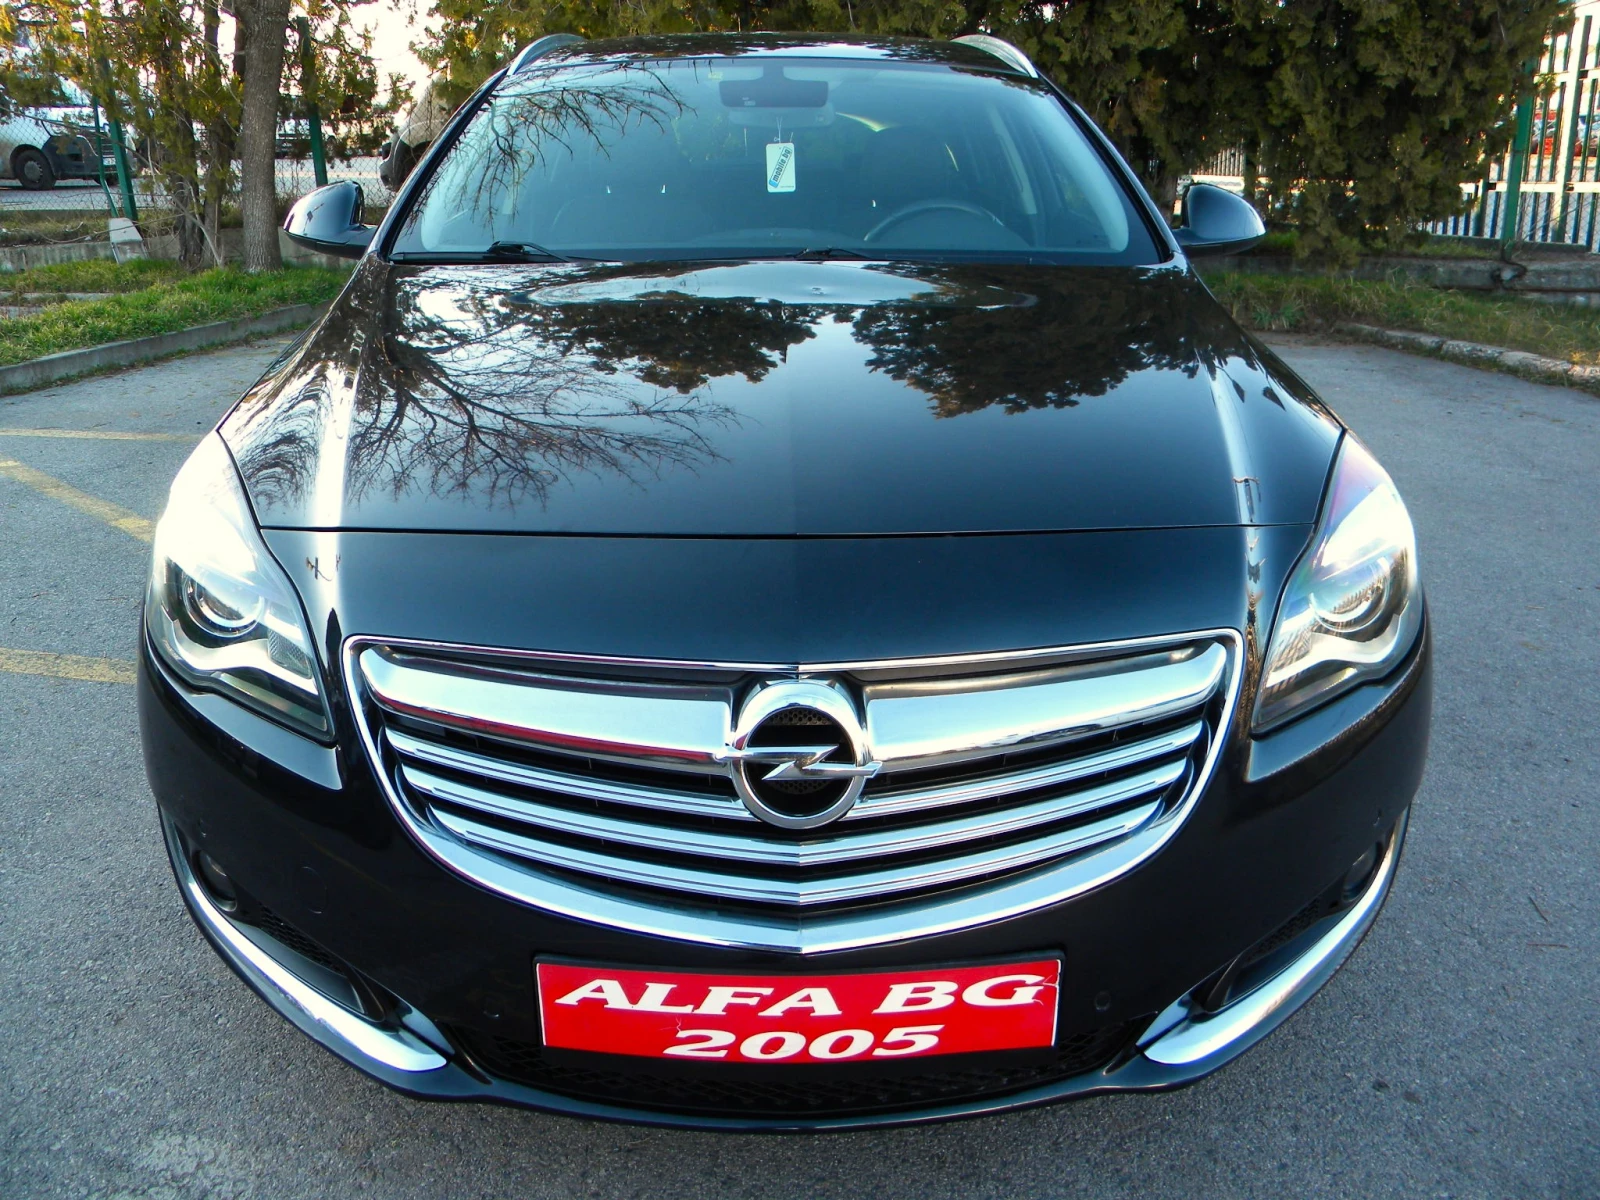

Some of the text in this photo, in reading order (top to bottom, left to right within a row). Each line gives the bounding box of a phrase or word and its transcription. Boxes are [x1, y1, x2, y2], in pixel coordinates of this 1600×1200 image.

[554, 974, 1045, 1016] ALFA BG
[663, 1025, 945, 1060] 2005
